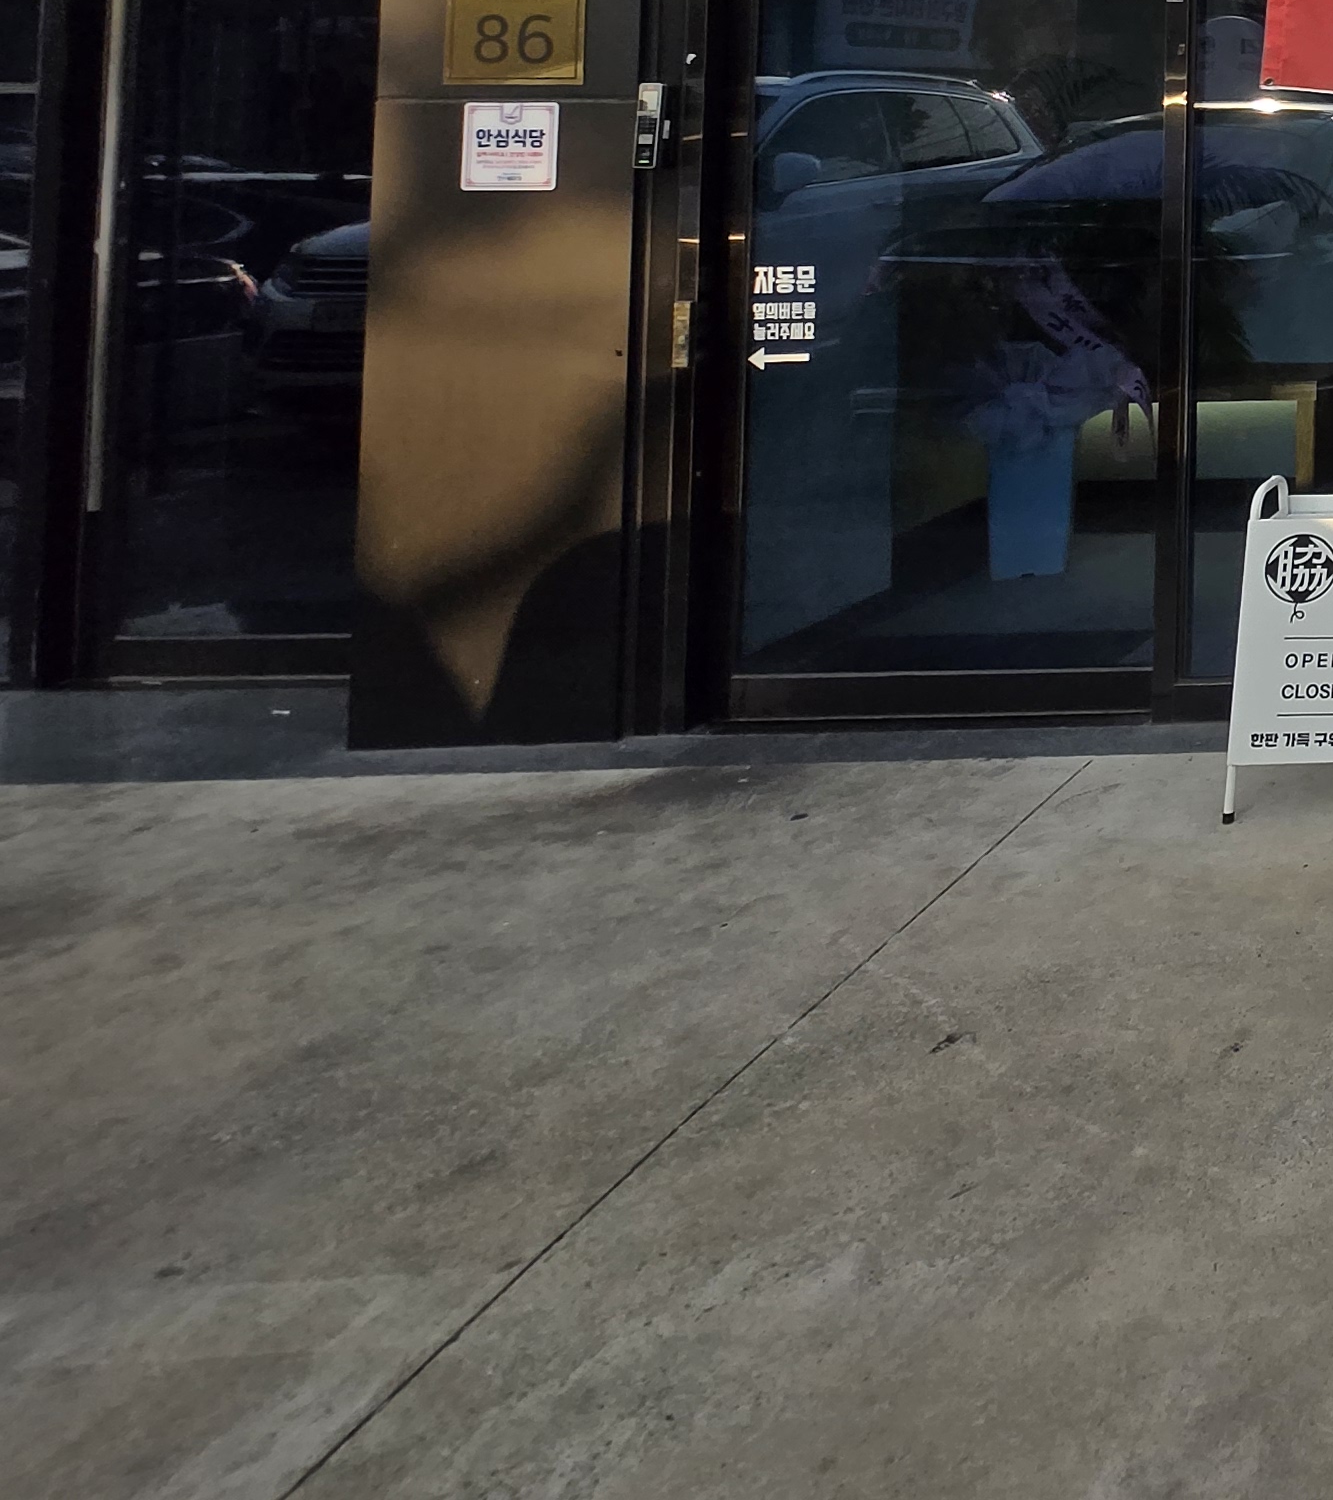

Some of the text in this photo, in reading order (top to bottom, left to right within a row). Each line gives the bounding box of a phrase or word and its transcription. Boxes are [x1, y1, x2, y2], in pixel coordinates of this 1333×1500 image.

[474, 13, 554, 64] 86
[476, 129, 546, 148] 안심식당
[753, 265, 816, 294] 자동문
[753, 322, 815, 340] 눌러주세요
[1250, 732, 1279, 747] 한판
[1283, 732, 1310, 747] 가득
